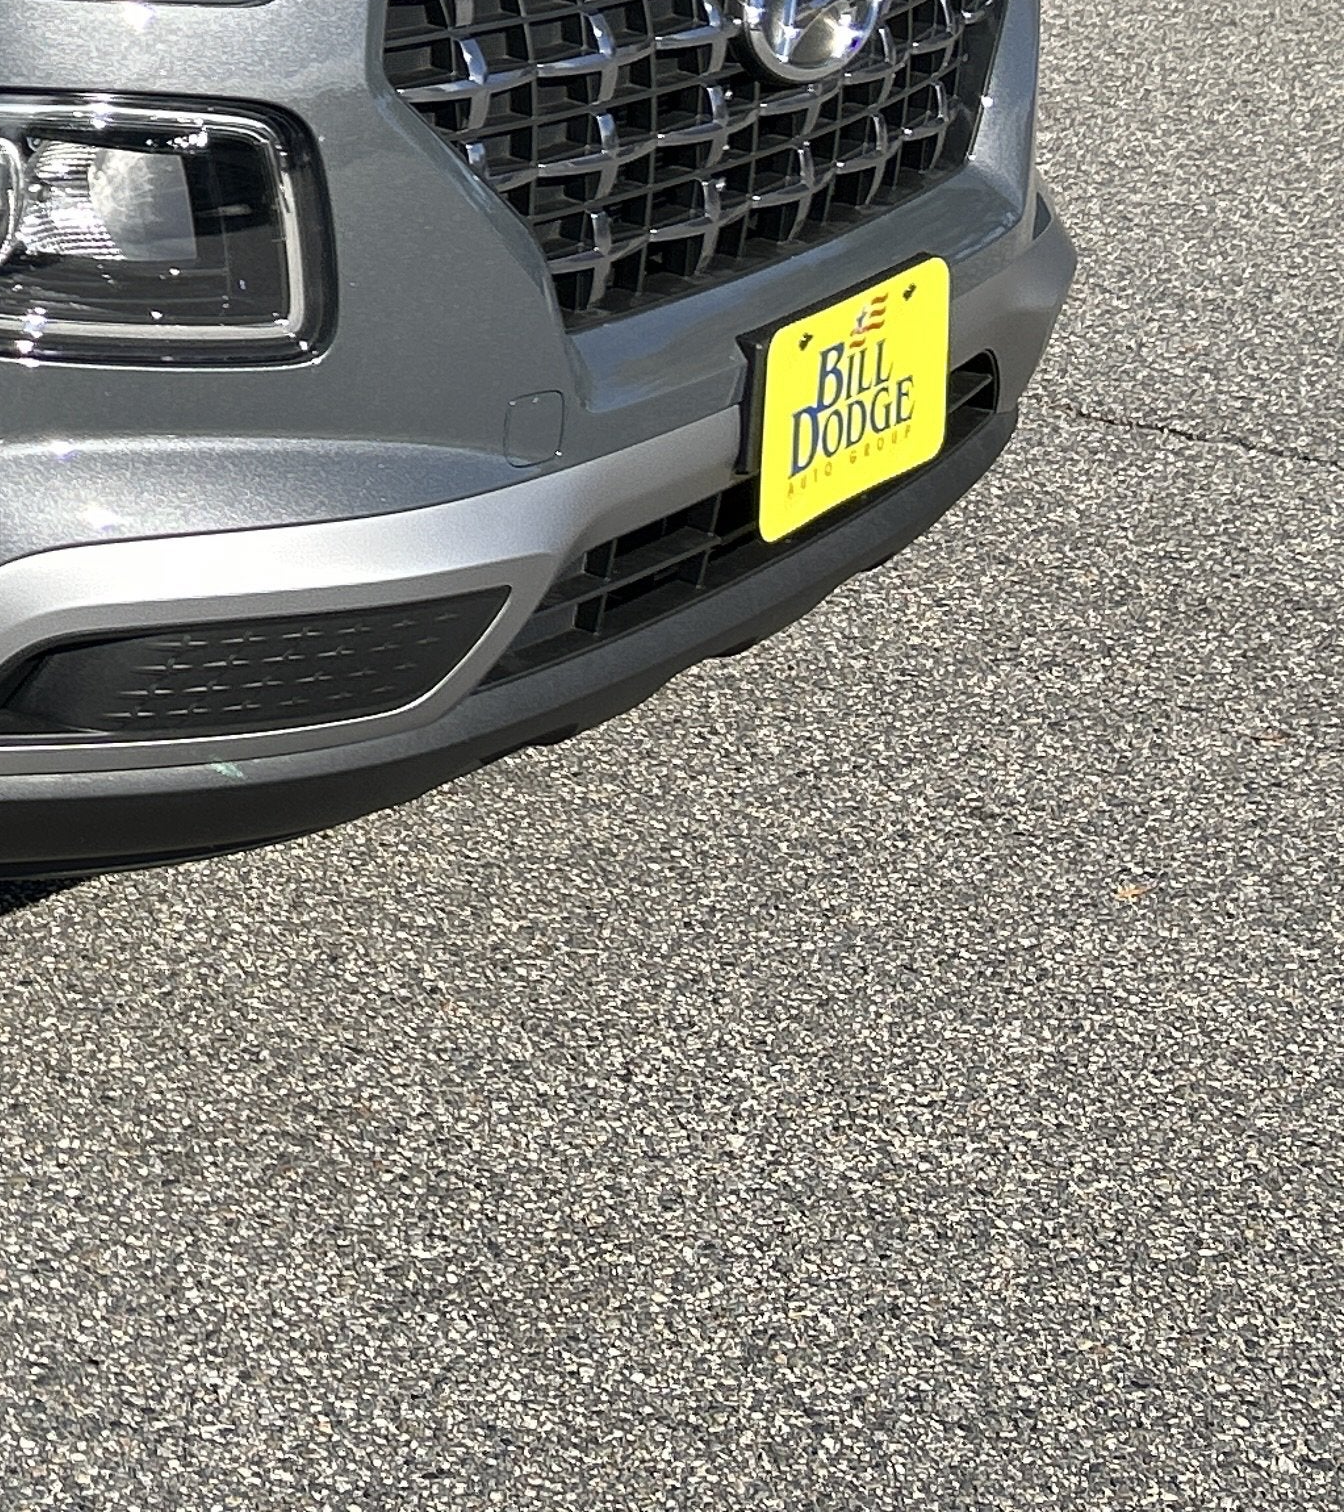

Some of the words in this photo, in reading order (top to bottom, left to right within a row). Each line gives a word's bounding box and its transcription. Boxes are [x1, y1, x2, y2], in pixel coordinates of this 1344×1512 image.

[816, 338, 894, 413] BILL
[787, 462, 832, 497] AUTO
[849, 425, 913, 465] GROUP
[789, 376, 915, 479] DODGE
